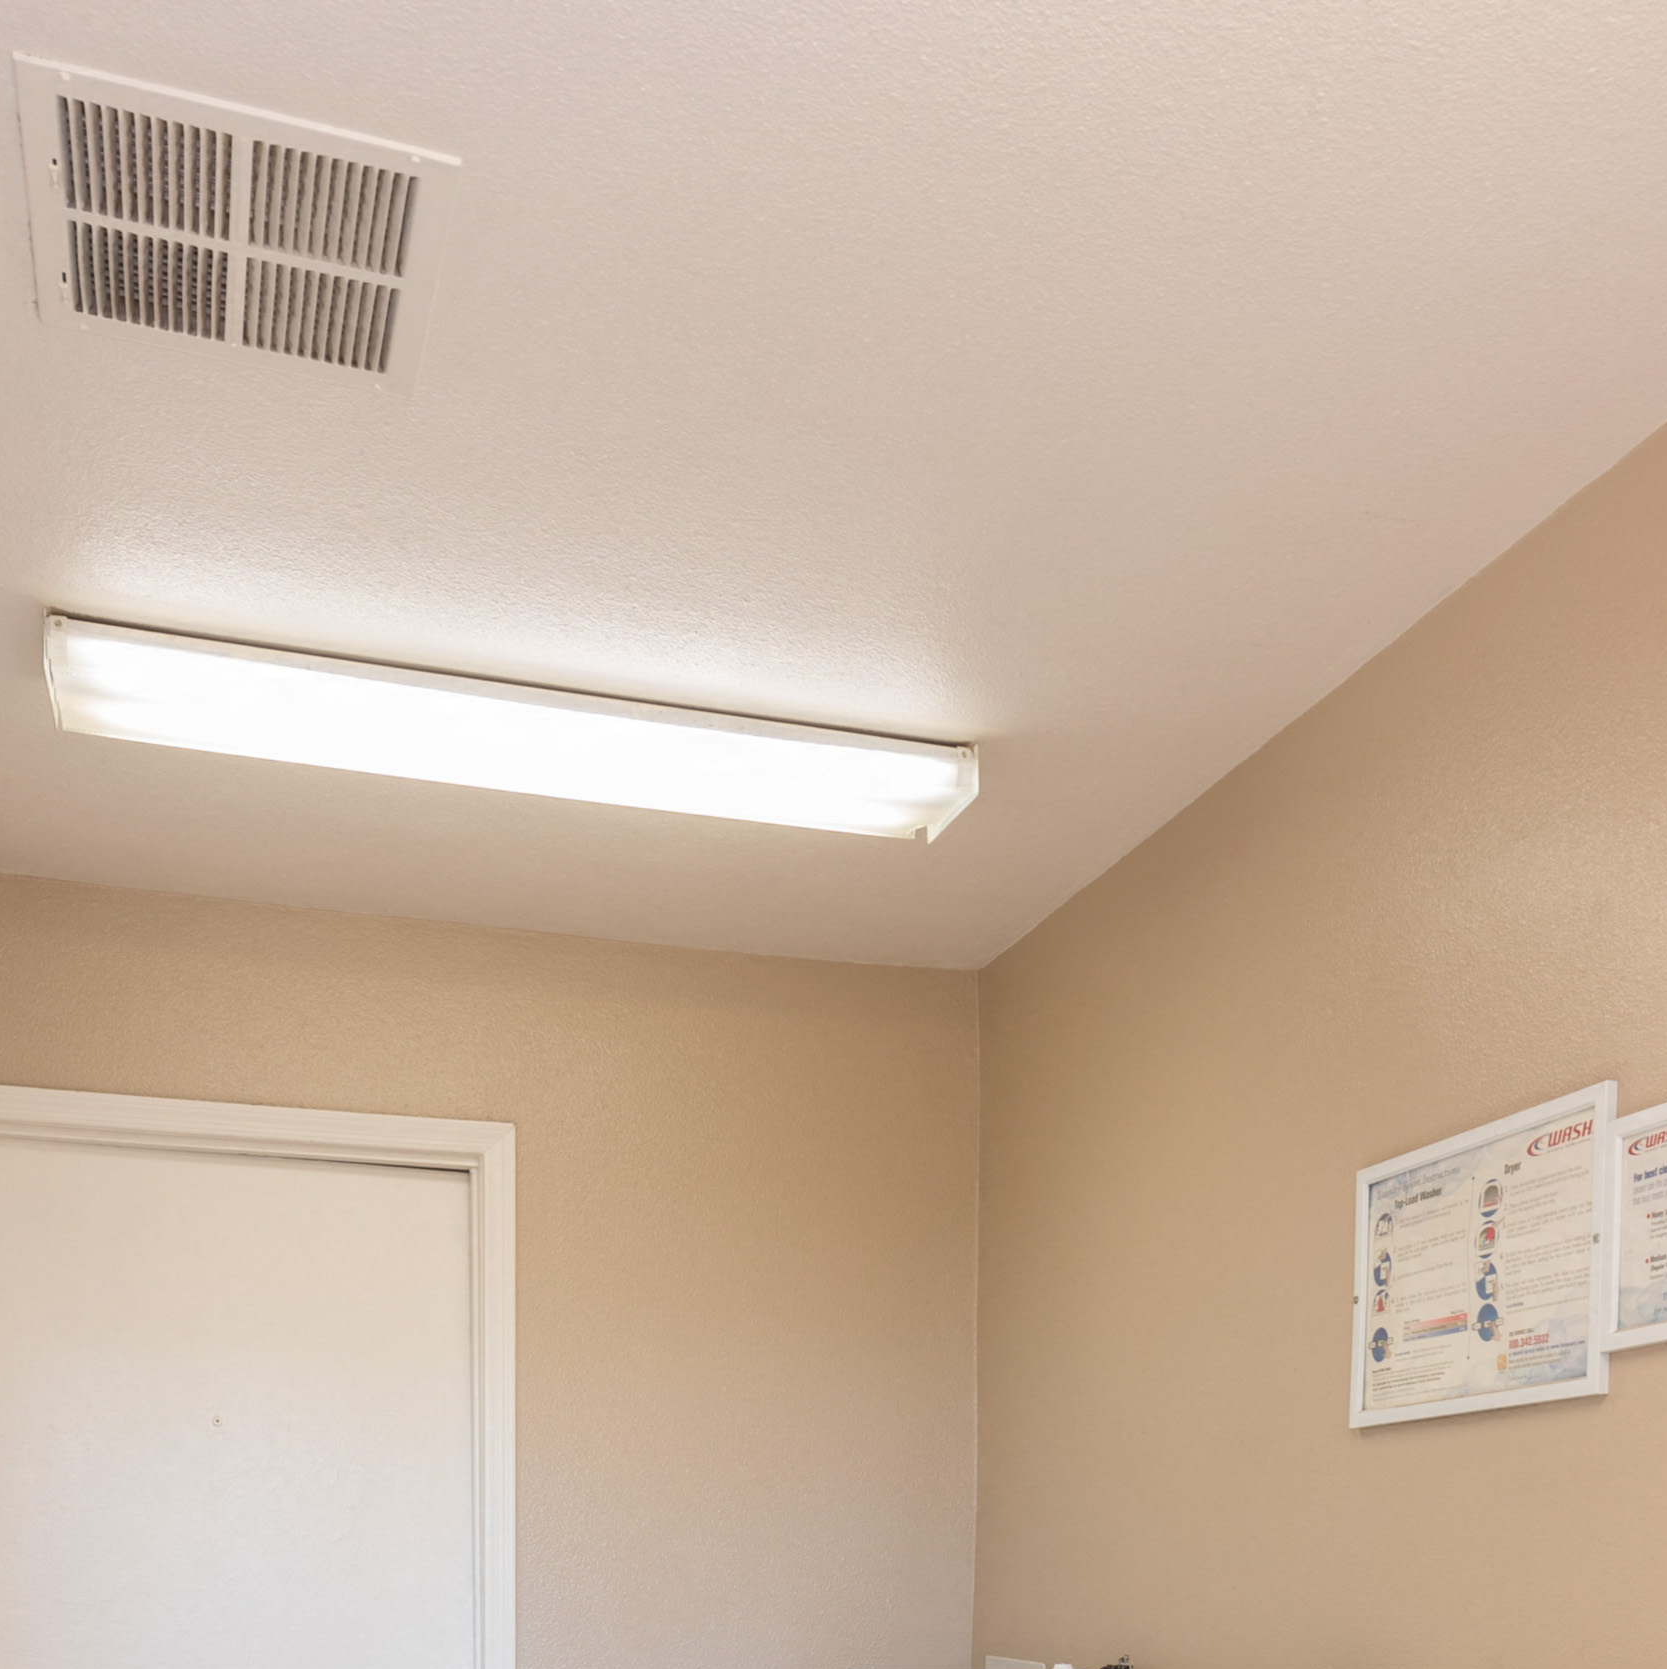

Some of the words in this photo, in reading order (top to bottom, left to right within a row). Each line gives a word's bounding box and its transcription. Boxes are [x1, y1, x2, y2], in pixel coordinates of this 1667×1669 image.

[1547, 1119, 1593, 1148] WASH
[1504, 1161, 1521, 1175] Dryer
[1633, 1172, 1642, 1182] For
[1644, 1167, 1657, 1179] best
[1394, 1192, 1419, 1209] Top-Load
[1420, 1186, 1442, 1203] Washer
